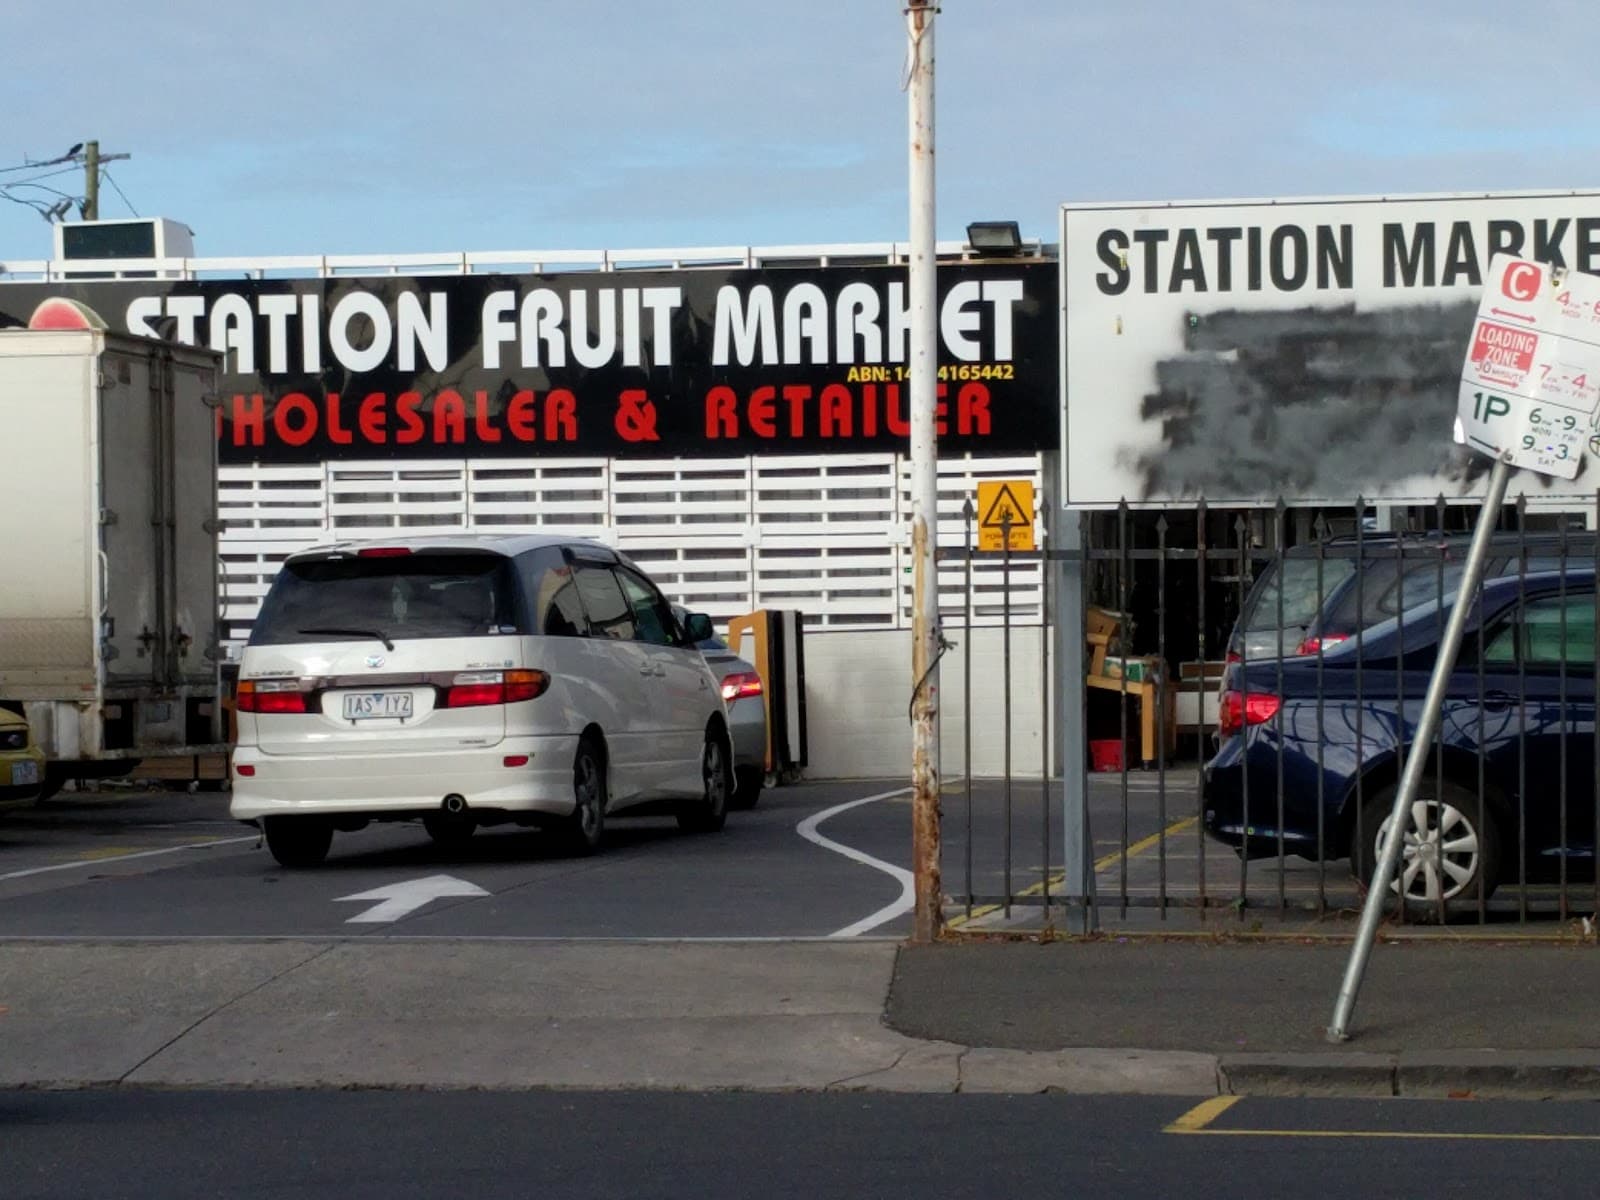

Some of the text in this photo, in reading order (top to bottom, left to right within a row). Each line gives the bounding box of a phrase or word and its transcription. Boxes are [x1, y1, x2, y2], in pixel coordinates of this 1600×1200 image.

[1095, 223, 1354, 296] STATION
[1509, 265, 1534, 298] C
[482, 286, 682, 368] FRUIT
[1479, 325, 1535, 353] LOADING
[1486, 345, 1521, 368] ZONE
[847, 364, 1015, 383] ABN: 144165442
[217, 388, 578, 447] HOLESALER
[614, 389, 661, 442] &
[1473, 392, 1511, 424] 1P
